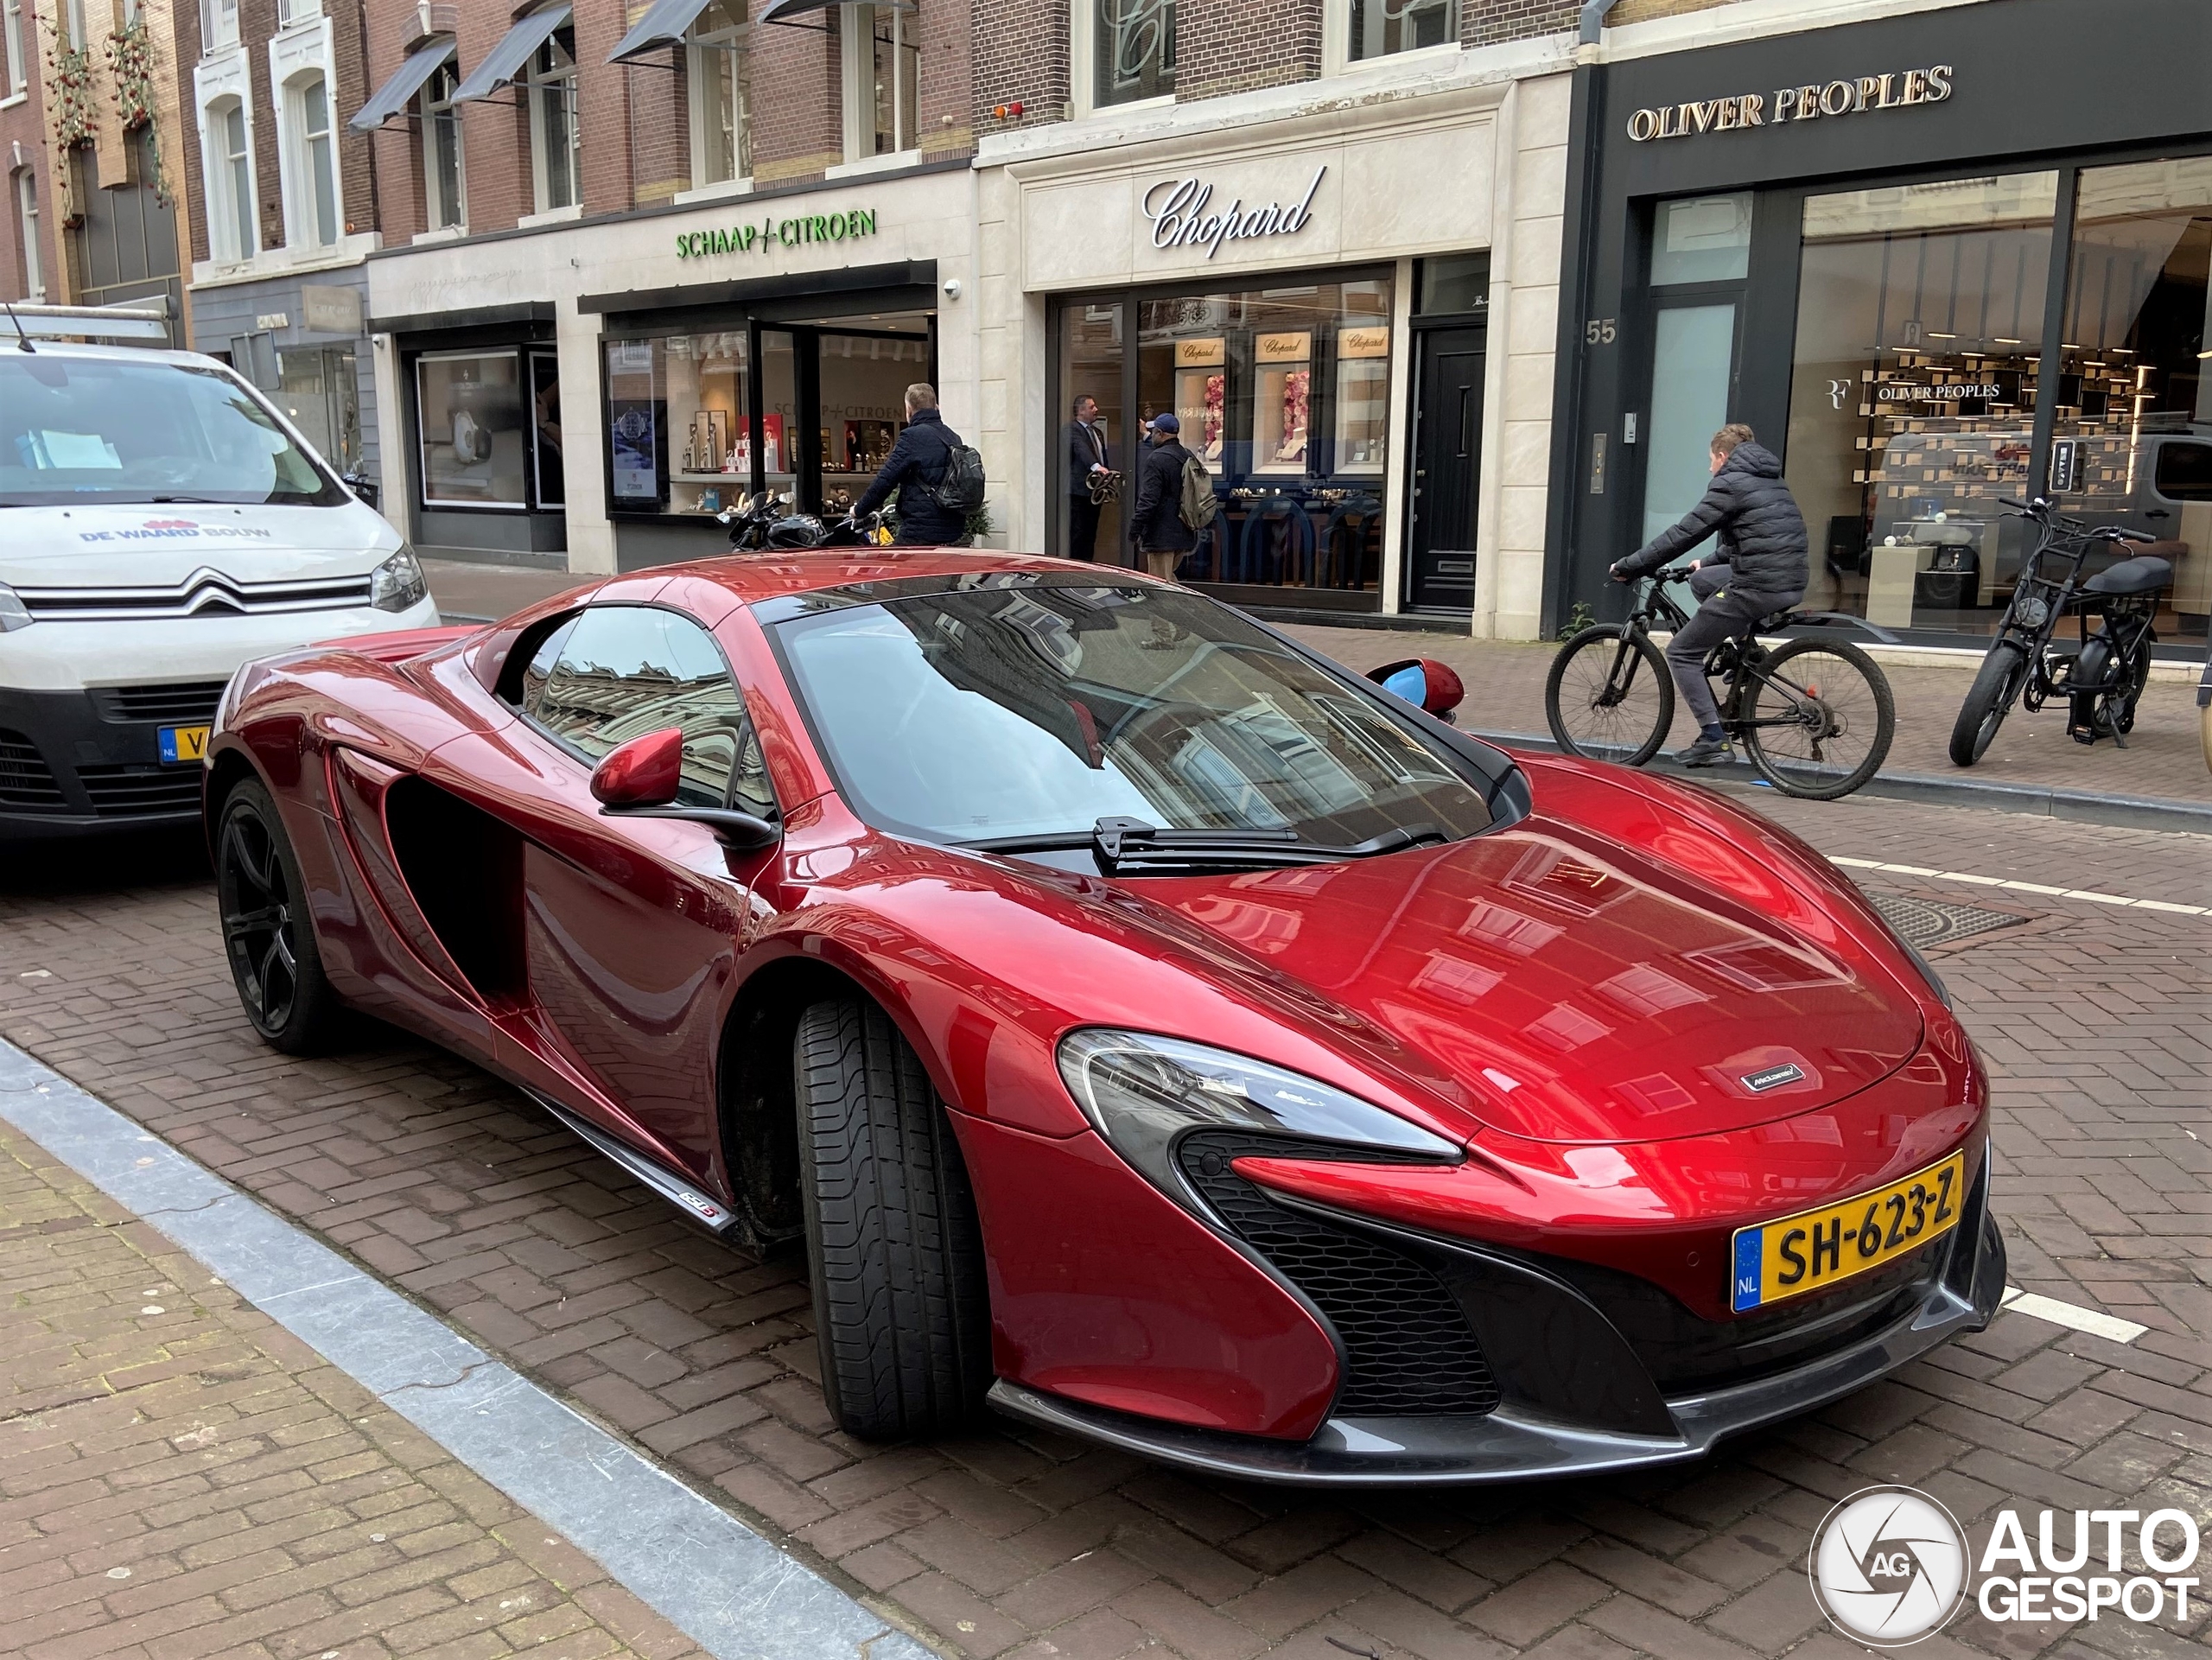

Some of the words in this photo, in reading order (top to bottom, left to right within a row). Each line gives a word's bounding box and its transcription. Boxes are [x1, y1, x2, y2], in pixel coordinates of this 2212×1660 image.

[1627, 94, 1765, 142] OLIVER
[1771, 65, 1953, 123] PEOPLES
[1141, 165, 1327, 258] Chopard
[1586, 318, 1616, 345] 55
[1264, 339, 1301, 356] Chopard
[1347, 334, 1386, 350] Chopard
[1183, 344, 1215, 359] Chopard
[1878, 387, 1931, 400] OLIVER
[1936, 385, 2000, 398] PEOPLES
[79, 531, 115, 541] DE
[116, 529, 200, 538] WAARD
[202, 528, 271, 537] BOUW
[1754, 1070, 1795, 1086] McLaren
[1778, 1166, 1955, 1284] SH-623-Z
[1738, 1276, 1758, 1295] NL
